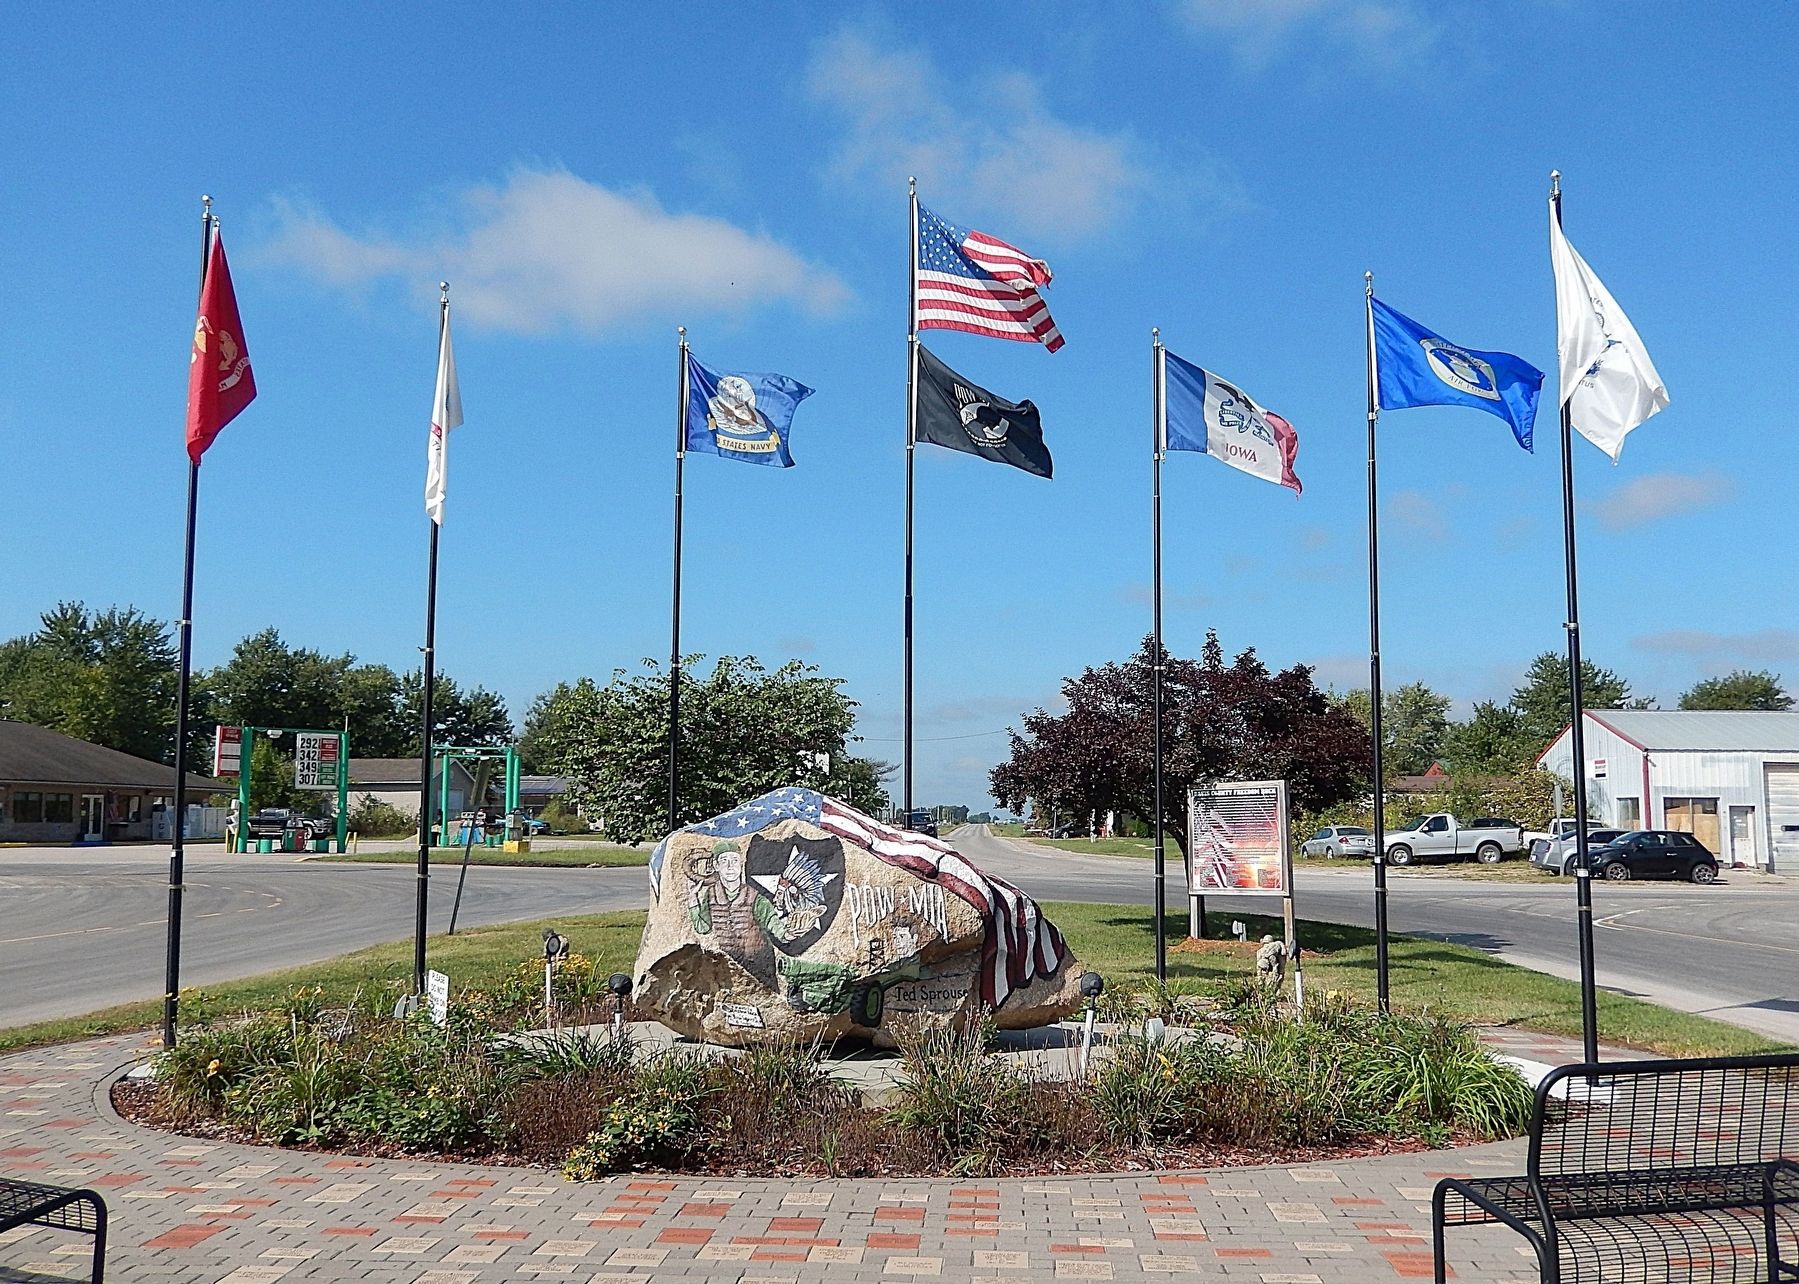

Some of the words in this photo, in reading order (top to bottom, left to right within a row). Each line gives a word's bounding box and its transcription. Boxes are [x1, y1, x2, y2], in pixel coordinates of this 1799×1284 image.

[722, 439, 747, 450] STATES
[1226, 443, 1257, 462] IOWA
[300, 738, 318, 749] 292
[300, 750, 317, 761] 342
[299, 761, 317, 773] 349
[298, 773, 316, 785] 307
[846, 882, 896, 950] POW
[908, 882, 949, 945] MIA
[894, 986, 917, 1002] Ted
[921, 985, 968, 1004] Sprouse
